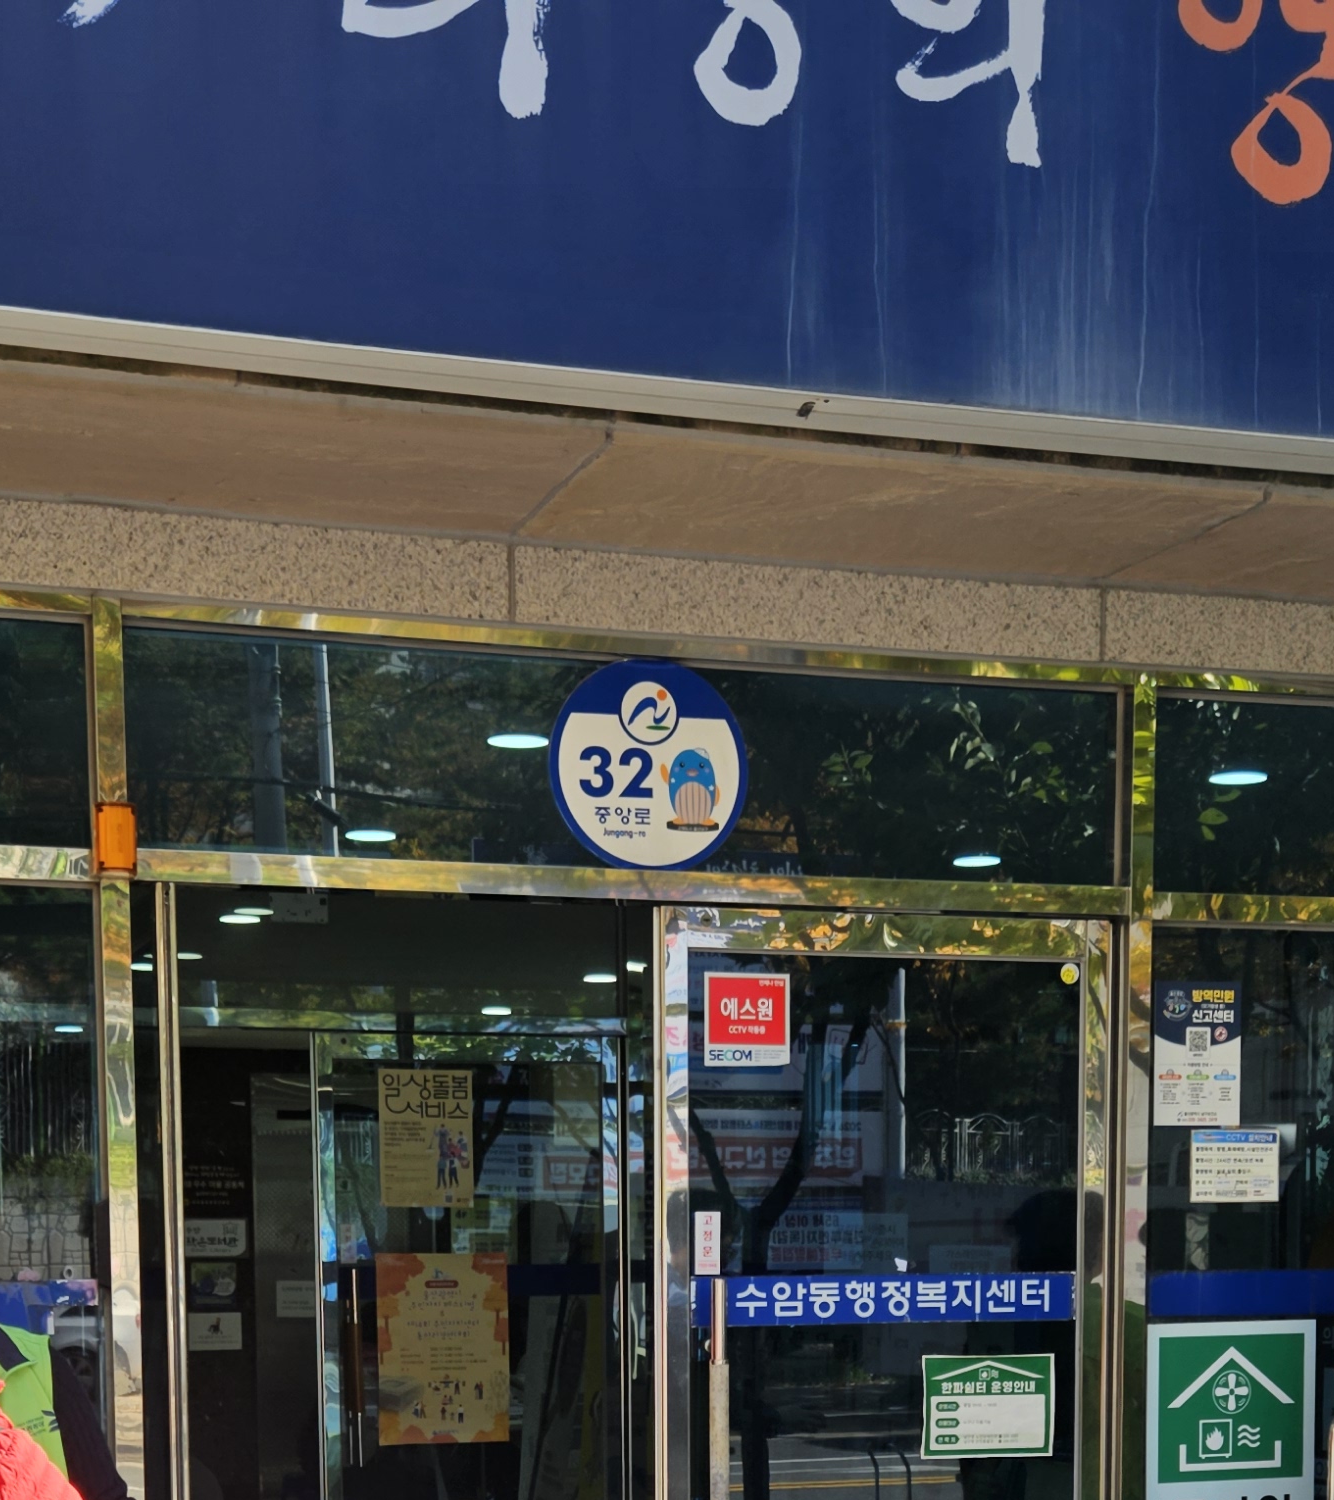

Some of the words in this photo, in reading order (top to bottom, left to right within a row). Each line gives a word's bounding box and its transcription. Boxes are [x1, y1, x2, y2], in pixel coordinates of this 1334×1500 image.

[579, 746, 653, 798] 32
[594, 806, 651, 825] 중앙로
[603, 828, 646, 839] Jungang-ro
[1192, 990, 1235, 1003] 방역민원
[720, 997, 773, 1021] 에스원
[1192, 1010, 1234, 1024] 신고센터
[728, 1025, 747, 1035] CCTV
[709, 1049, 752, 1062] SECOM
[382, 1074, 469, 1101] 일상돌봄
[403, 1101, 469, 1119] 서비스
[734, 1277, 1051, 1320] 수암동행정복지센터
[941, 1381, 987, 1394] 한파쉼터
[991, 1380, 1036, 1393] 운영안내
